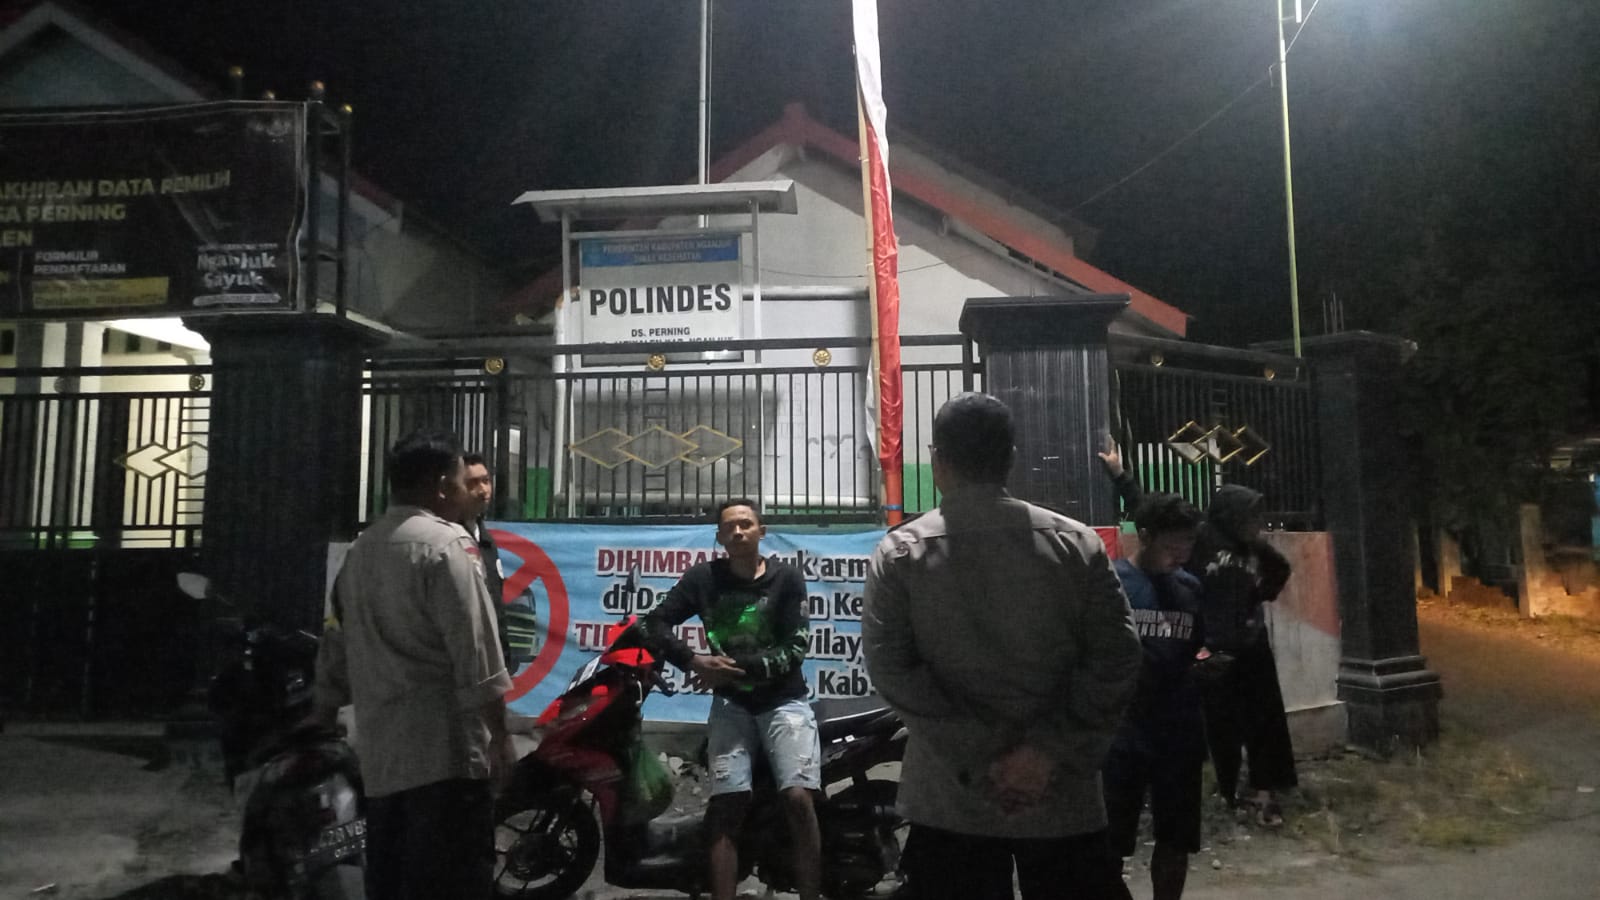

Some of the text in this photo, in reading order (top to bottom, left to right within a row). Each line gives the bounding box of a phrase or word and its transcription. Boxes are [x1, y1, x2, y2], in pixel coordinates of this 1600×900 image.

[0, 169, 231, 199] KHIRAN DATA PEMILIH
[26, 203, 126, 223] PERNING
[0, 229, 33, 247] EN
[35, 250, 98, 262] FORMULIR
[34, 263, 126, 275] PENDAFTARAN
[590, 283, 731, 316] POLINDES
[631, 326, 690, 338] DS. PERNING
[597, 549, 729, 574] DIHIMBA
